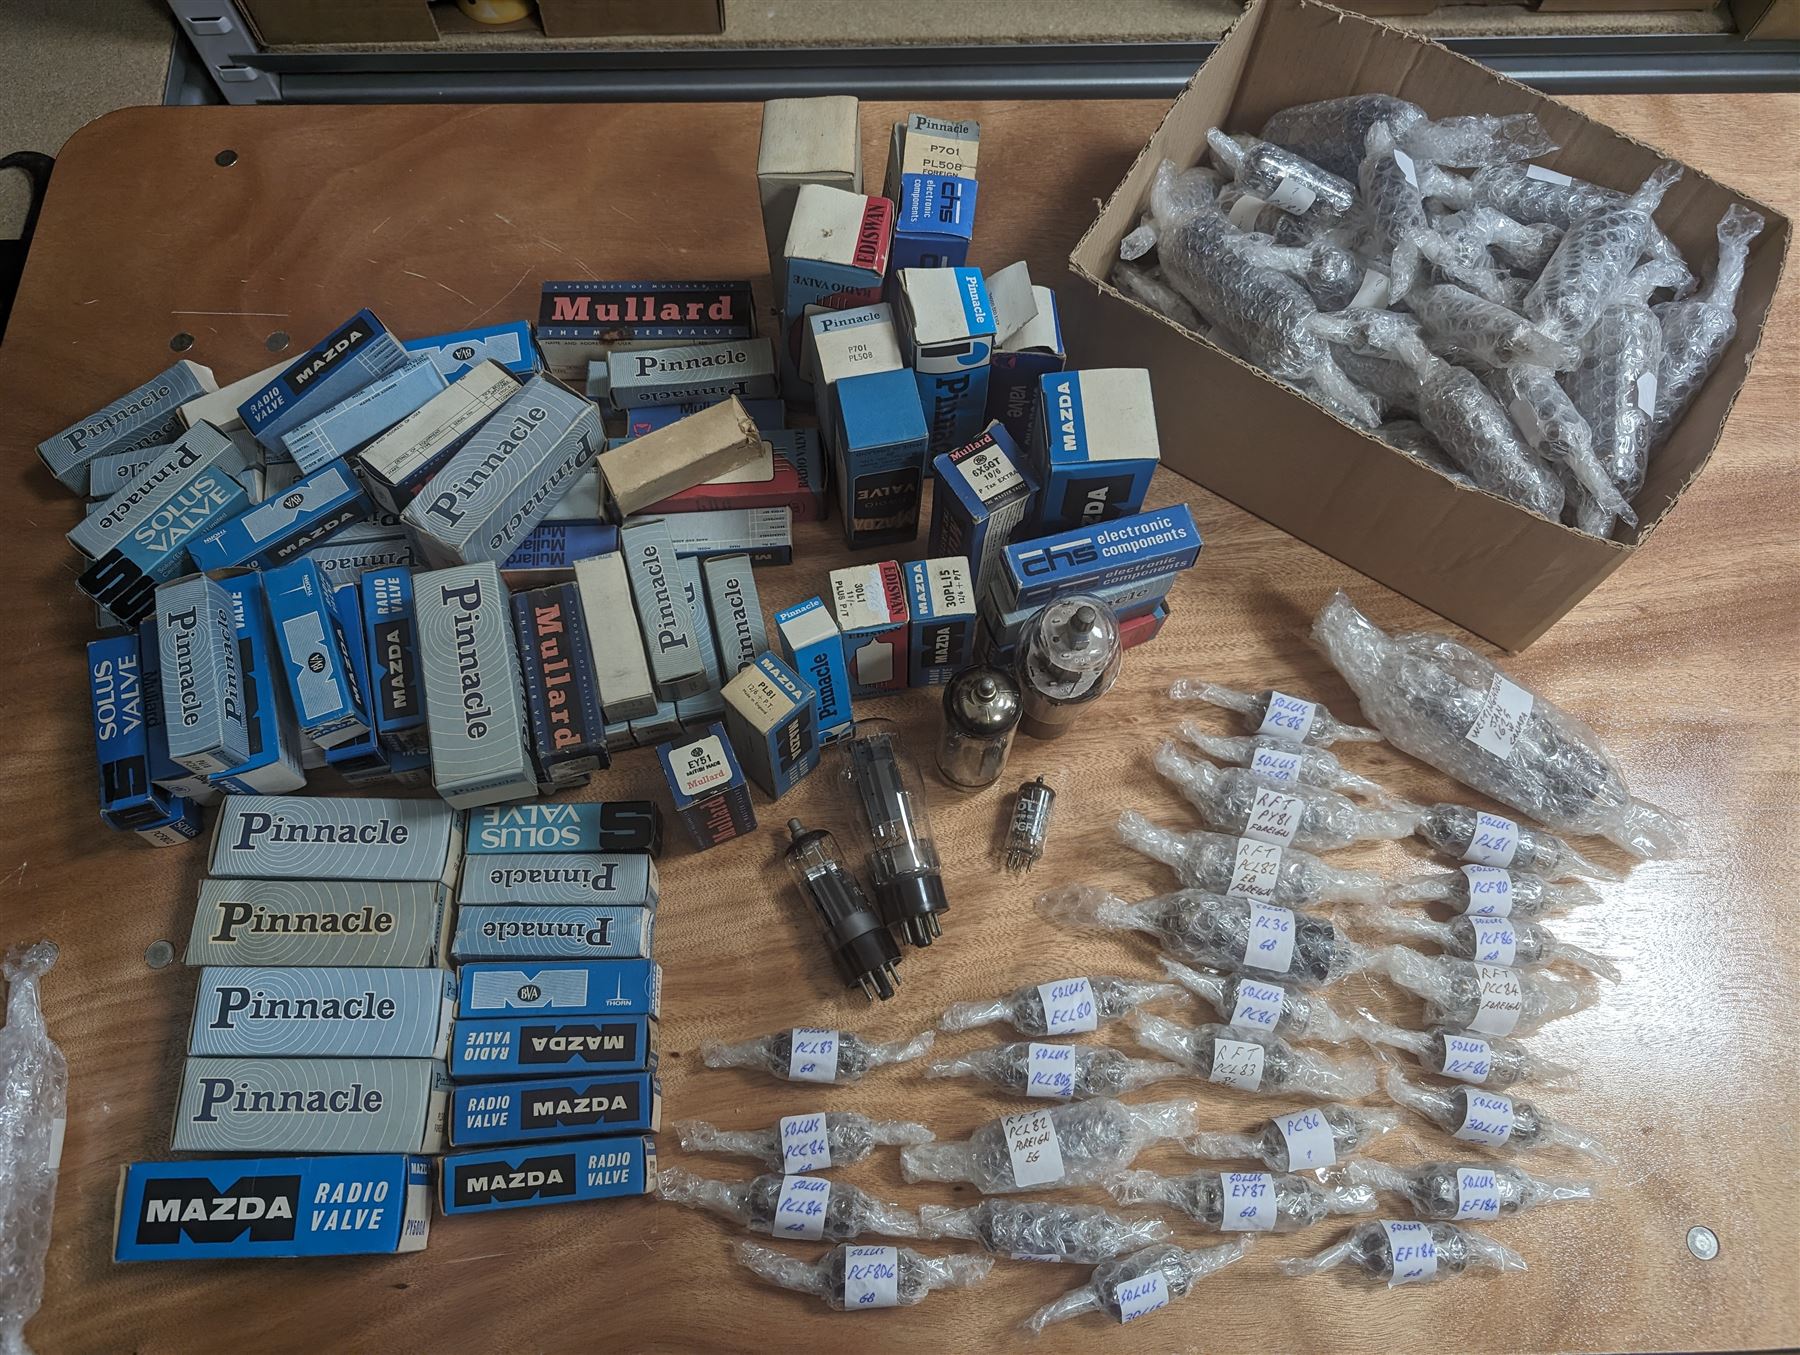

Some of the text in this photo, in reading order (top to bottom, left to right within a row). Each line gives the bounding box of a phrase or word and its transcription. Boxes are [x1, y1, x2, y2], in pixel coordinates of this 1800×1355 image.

[915, 117, 969, 134] Pinnacle
[930, 145, 960, 155] P701
[922, 159, 962, 171] PL508
[911, 179, 921, 223] components
[923, 180, 934, 218] electronic
[857, 203, 886, 265] EDISWAN
[793, 275, 829, 290] VALVE
[551, 295, 734, 322] Mullard
[965, 275, 986, 324] Pinnacle
[677, 328, 734, 336] VALVE
[821, 312, 880, 332] Pinnacle
[295, 331, 363, 384] MAZDA
[848, 344, 867, 353] P701
[849, 352, 873, 362] PL508
[635, 350, 748, 378] Pinnacle
[250, 387, 280, 414] RADIO
[639, 381, 750, 402] Pinnacle
[1007, 385, 1027, 418] valve
[63, 386, 170, 455] Pinnacle
[254, 397, 285, 422] VALVE
[1059, 382, 1076, 451] MAZDA
[950, 434, 992, 461] Mullard
[426, 407, 547, 528] Pinnacle
[972, 457, 1001, 477] 6X5GT
[998, 470, 1018, 483] EXTRA
[100, 442, 202, 528] Pinnacle
[490, 430, 597, 549] Pinnacle
[134, 476, 216, 545] SOLUS
[149, 487, 231, 552] VALVE
[204, 530, 227, 543] THORN
[278, 512, 354, 557] MAZDA
[1097, 516, 1173, 545] electronic
[1102, 528, 1187, 557] components
[1103, 559, 1188, 585] components
[1105, 556, 1177, 578] electronic
[303, 575, 312, 596] THORN
[374, 578, 389, 615] RADIO
[388, 576, 404, 613] VALVE
[884, 565, 904, 615] EDISWAN
[914, 564, 928, 614] MAZDA
[940, 569, 956, 608] 30PL15
[232, 591, 246, 629] VALVE
[643, 544, 690, 655] Pinnacle
[780, 599, 820, 620] Pinnacle
[519, 611, 537, 699] THE MASTER
[935, 627, 950, 663] MAZDA
[167, 606, 202, 727] Pinnacle
[217, 608, 243, 728] Pinnacle
[386, 629, 407, 709] MAZDA
[441, 578, 493, 740] Pinnacle
[534, 603, 582, 750] Mullard
[761, 658, 803, 700] MAZDA
[810, 652, 838, 720] Pinnacle
[94, 660, 117, 741] SOLUS
[118, 654, 142, 736] VALVE
[758, 682, 776, 700] PL81
[1272, 697, 1308, 715] SOLUS
[1268, 711, 1304, 731] PC88
[788, 718, 801, 760] MAZDA
[688, 754, 712, 769] EY51
[706, 761, 721, 769] MADE
[1255, 754, 1297, 770] SOLUS
[687, 770, 725, 789] Mullard
[483, 805, 582, 826] VALVE
[1257, 809, 1292, 827] PY81
[174, 817, 198, 837] SOLUS
[232, 812, 409, 850] Pinnacle
[480, 826, 582, 848] SOLUS
[1475, 834, 1508, 852] PL81
[491, 863, 619, 891] Pinnacle
[1237, 860, 1276, 876] PCL82
[1473, 881, 1508, 894] PCF80
[212, 902, 393, 942] Pinnacle
[483, 918, 614, 947] Pinnacle
[1256, 915, 1289, 932] PL36
[1480, 931, 1513, 946] PCF86
[520, 986, 538, 999] BVA
[1052, 981, 1087, 1002] SOLUS
[209, 987, 395, 1029] Pinnacle
[1051, 1001, 1091, 1026] ECL80
[1240, 1007, 1271, 1024] PC86
[466, 1031, 511, 1044] VALVE
[532, 1036, 625, 1051] MAZDA
[795, 1040, 833, 1054] PCL83
[1450, 1040, 1484, 1053] SOLUS
[464, 1047, 509, 1060] RADIO
[1035, 1048, 1070, 1059] SOLUS
[1447, 1061, 1489, 1076] PCF86
[193, 1078, 382, 1122] Pinnacle
[467, 1096, 510, 1111] RADIO
[533, 1096, 628, 1117] MAZDA
[1472, 1096, 1510, 1114] SOLUS
[466, 1113, 508, 1129] VALVE
[785, 1119, 820, 1137] SOLUS
[1008, 1118, 1048, 1137] PCL82
[1287, 1112, 1320, 1136] PC86
[785, 1140, 825, 1157] PCC84
[588, 1152, 631, 1169] RADIO
[467, 1169, 564, 1193] MAZDA
[587, 1169, 629, 1186] VALVE
[791, 1181, 828, 1192] SOLUS
[1462, 1174, 1495, 1191] SOLUS
[314, 1181, 389, 1204] RADIO
[1232, 1184, 1265, 1197] EY87
[146, 1196, 294, 1222] MAZDA
[779, 1198, 823, 1215] PCL84
[1461, 1199, 1498, 1213] EF184
[310, 1208, 384, 1231] VALVE
[851, 1248, 885, 1257] SOLUS
[1395, 1243, 1435, 1262] EF184
[1121, 1280, 1157, 1304] SOLUS
